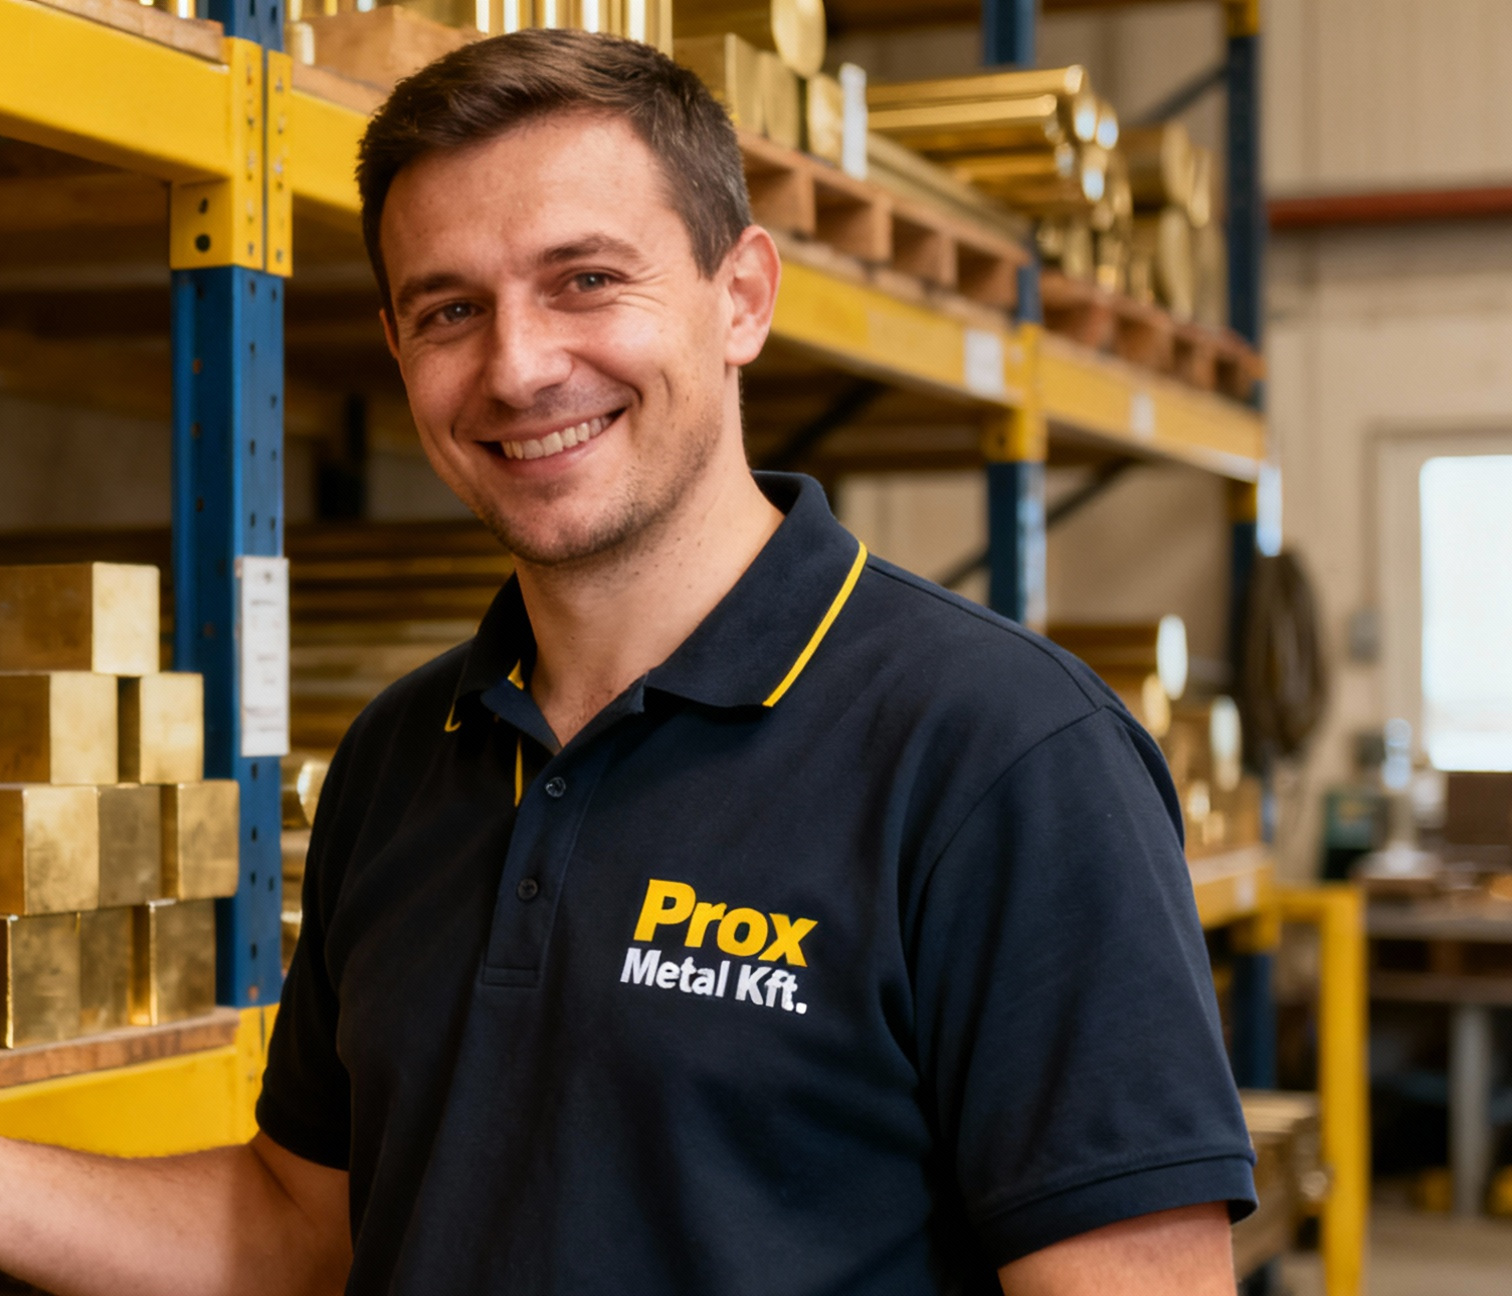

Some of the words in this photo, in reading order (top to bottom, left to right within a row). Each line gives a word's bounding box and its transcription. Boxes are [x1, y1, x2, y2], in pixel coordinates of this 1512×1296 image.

[633, 878, 819, 968] Prox
[619, 947, 731, 998] Metal
[735, 964, 808, 1014] Kft.
